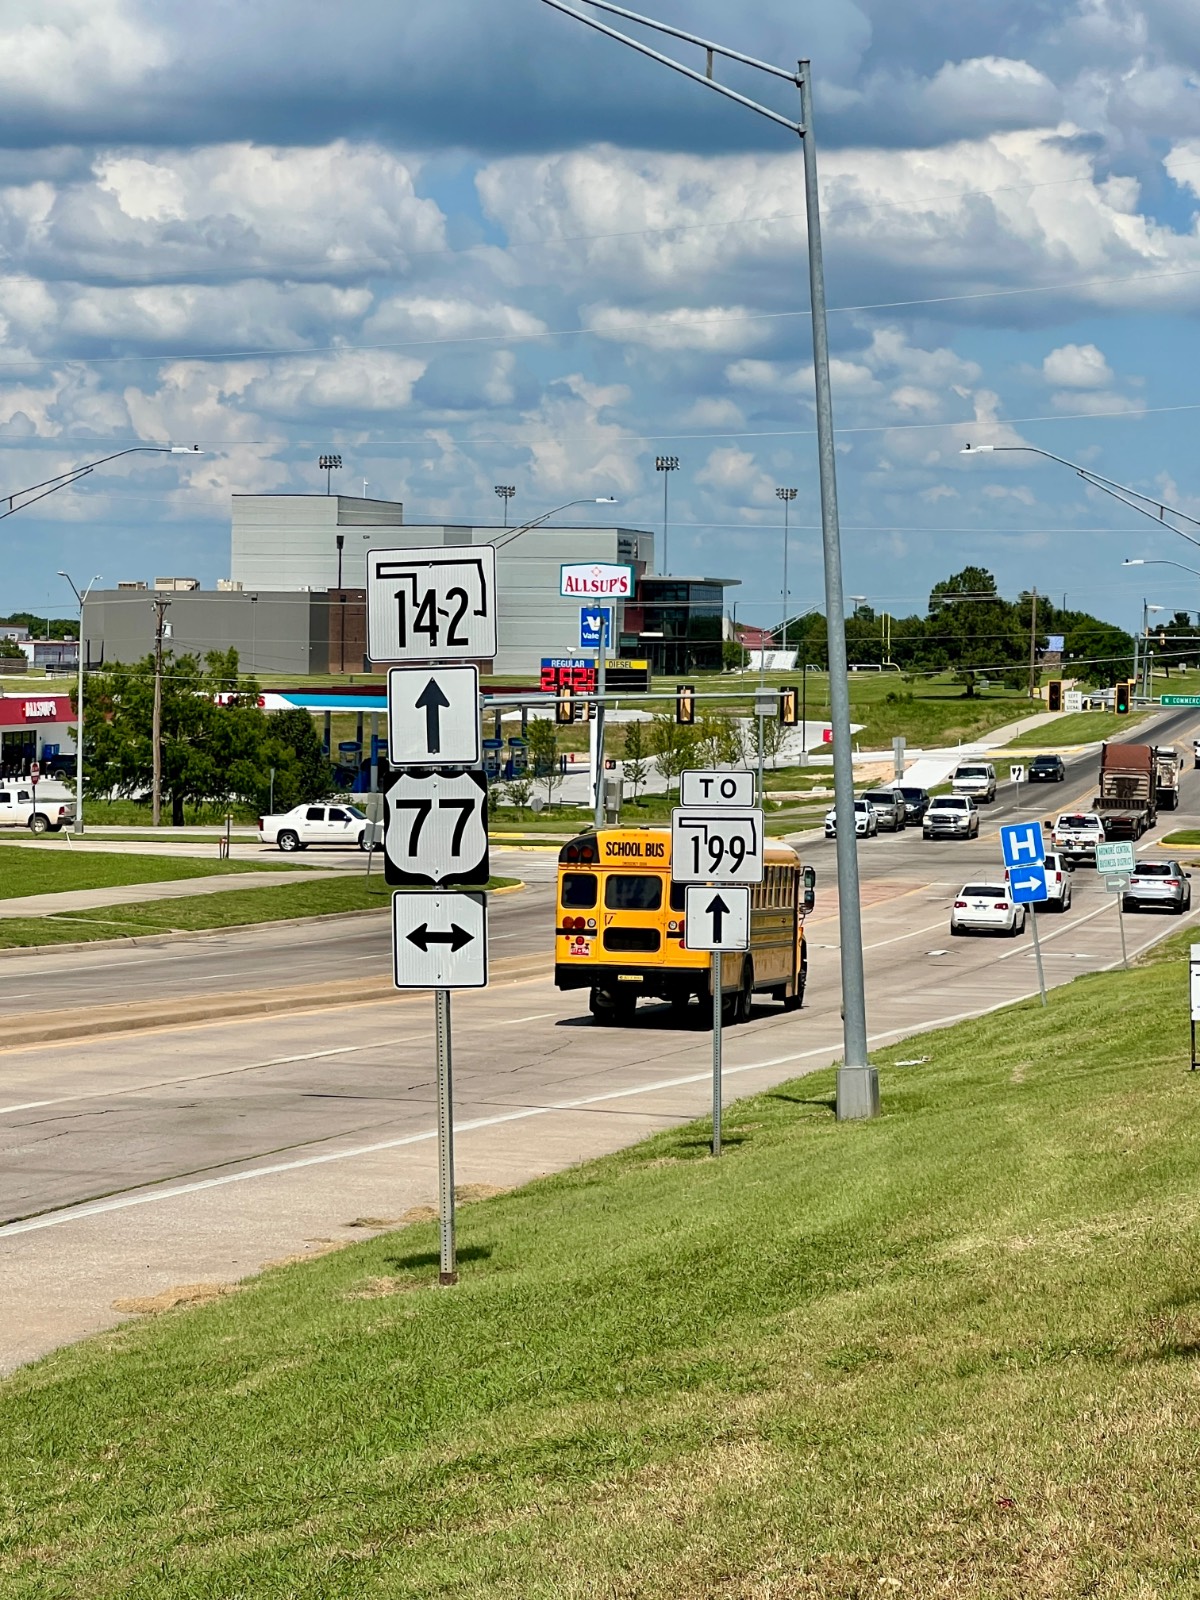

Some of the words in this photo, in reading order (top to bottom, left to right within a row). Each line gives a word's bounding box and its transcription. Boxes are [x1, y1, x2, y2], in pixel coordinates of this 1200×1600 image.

[564, 575, 628, 593] ALLSUP'S
[393, 587, 469, 648] 142
[582, 632, 608, 640] Valer
[551, 660, 585, 668] REGULAR
[608, 661, 633, 669] DIESEL
[699, 778, 737, 799] TO
[395, 798, 476, 858] 77
[605, 841, 644, 857] SCHOOL
[645, 842, 665, 858] BUS
[1009, 828, 1036, 860] H
[691, 835, 746, 874] 199
